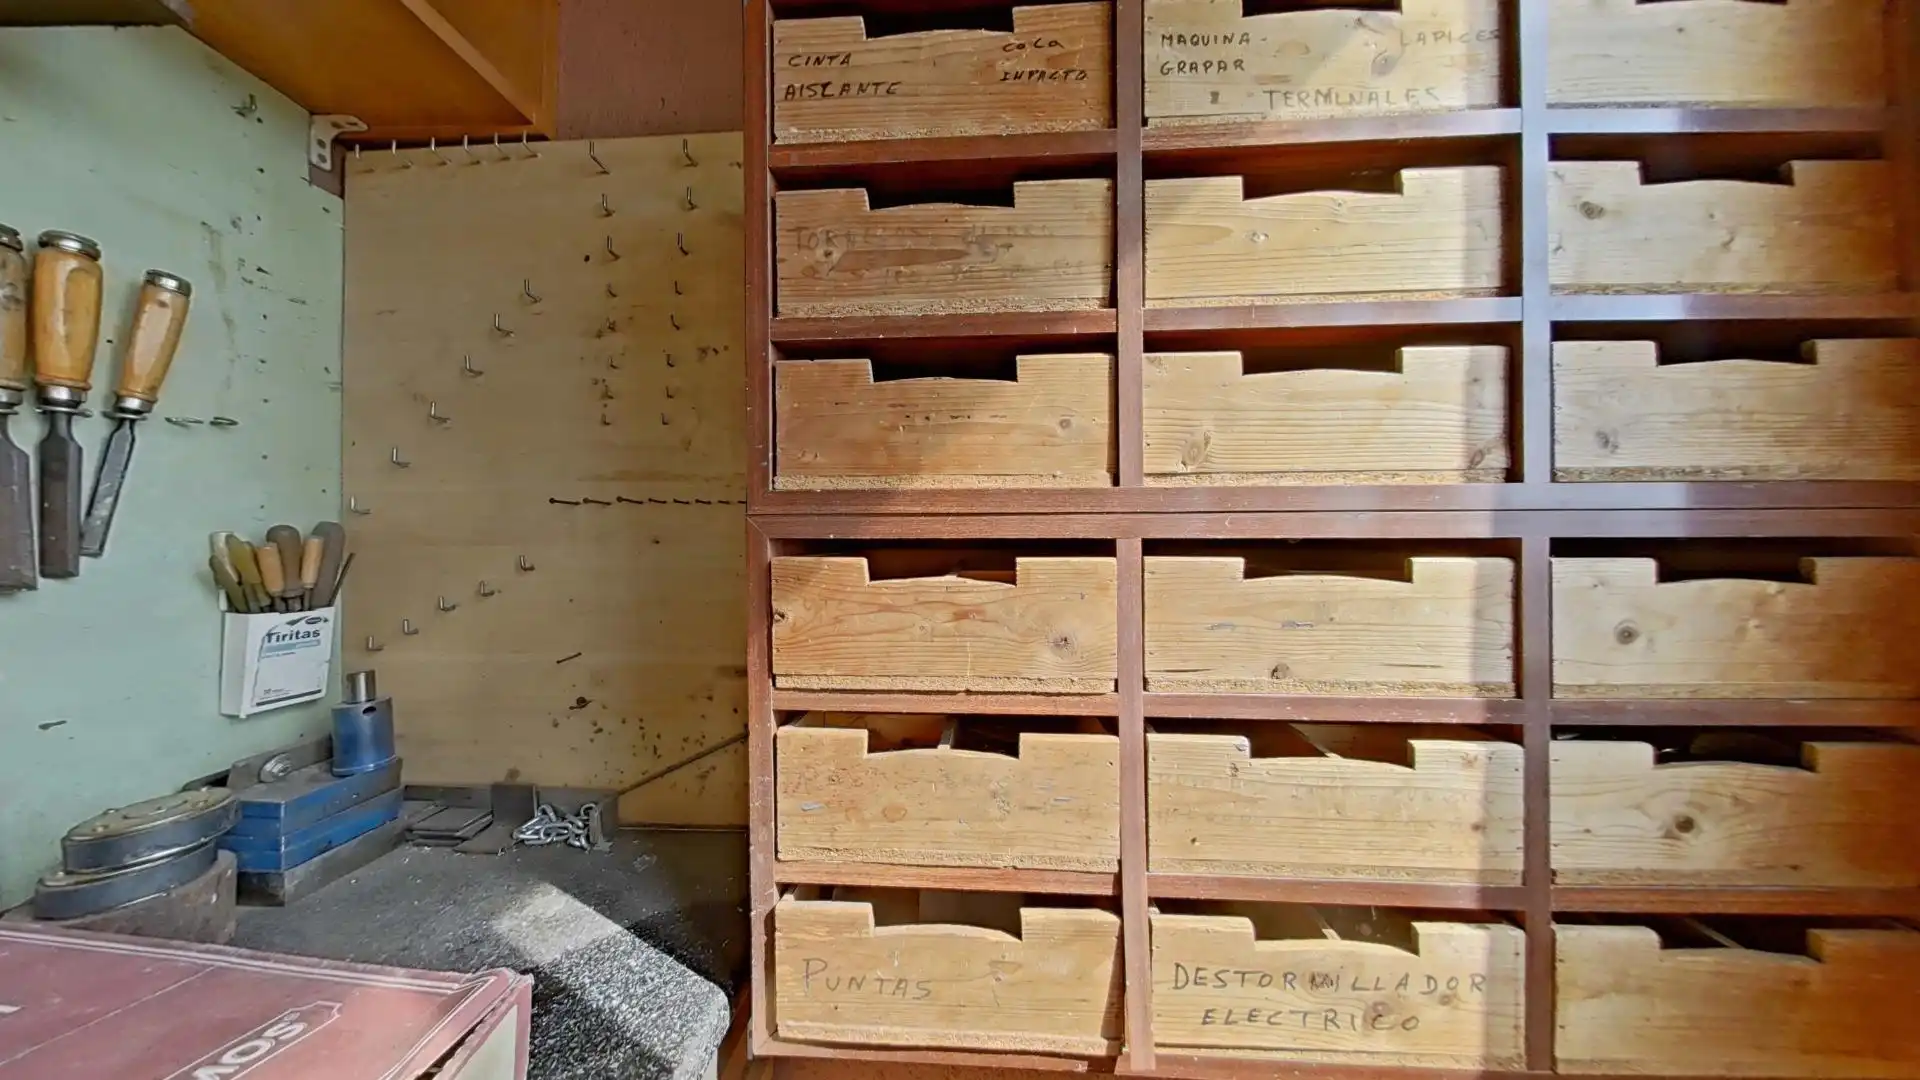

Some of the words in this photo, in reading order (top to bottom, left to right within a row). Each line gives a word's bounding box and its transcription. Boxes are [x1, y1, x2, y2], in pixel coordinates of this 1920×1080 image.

[788, 52, 852, 67] CINTA
[1160, 59, 1246, 76] GRAPAR
[784, 80, 902, 101] AISLANTE
[1262, 87, 1440, 110] TERMINALES
[266, 629, 321, 643] Tiritas
[1201, 1008, 1420, 1032] ELECTRICO
